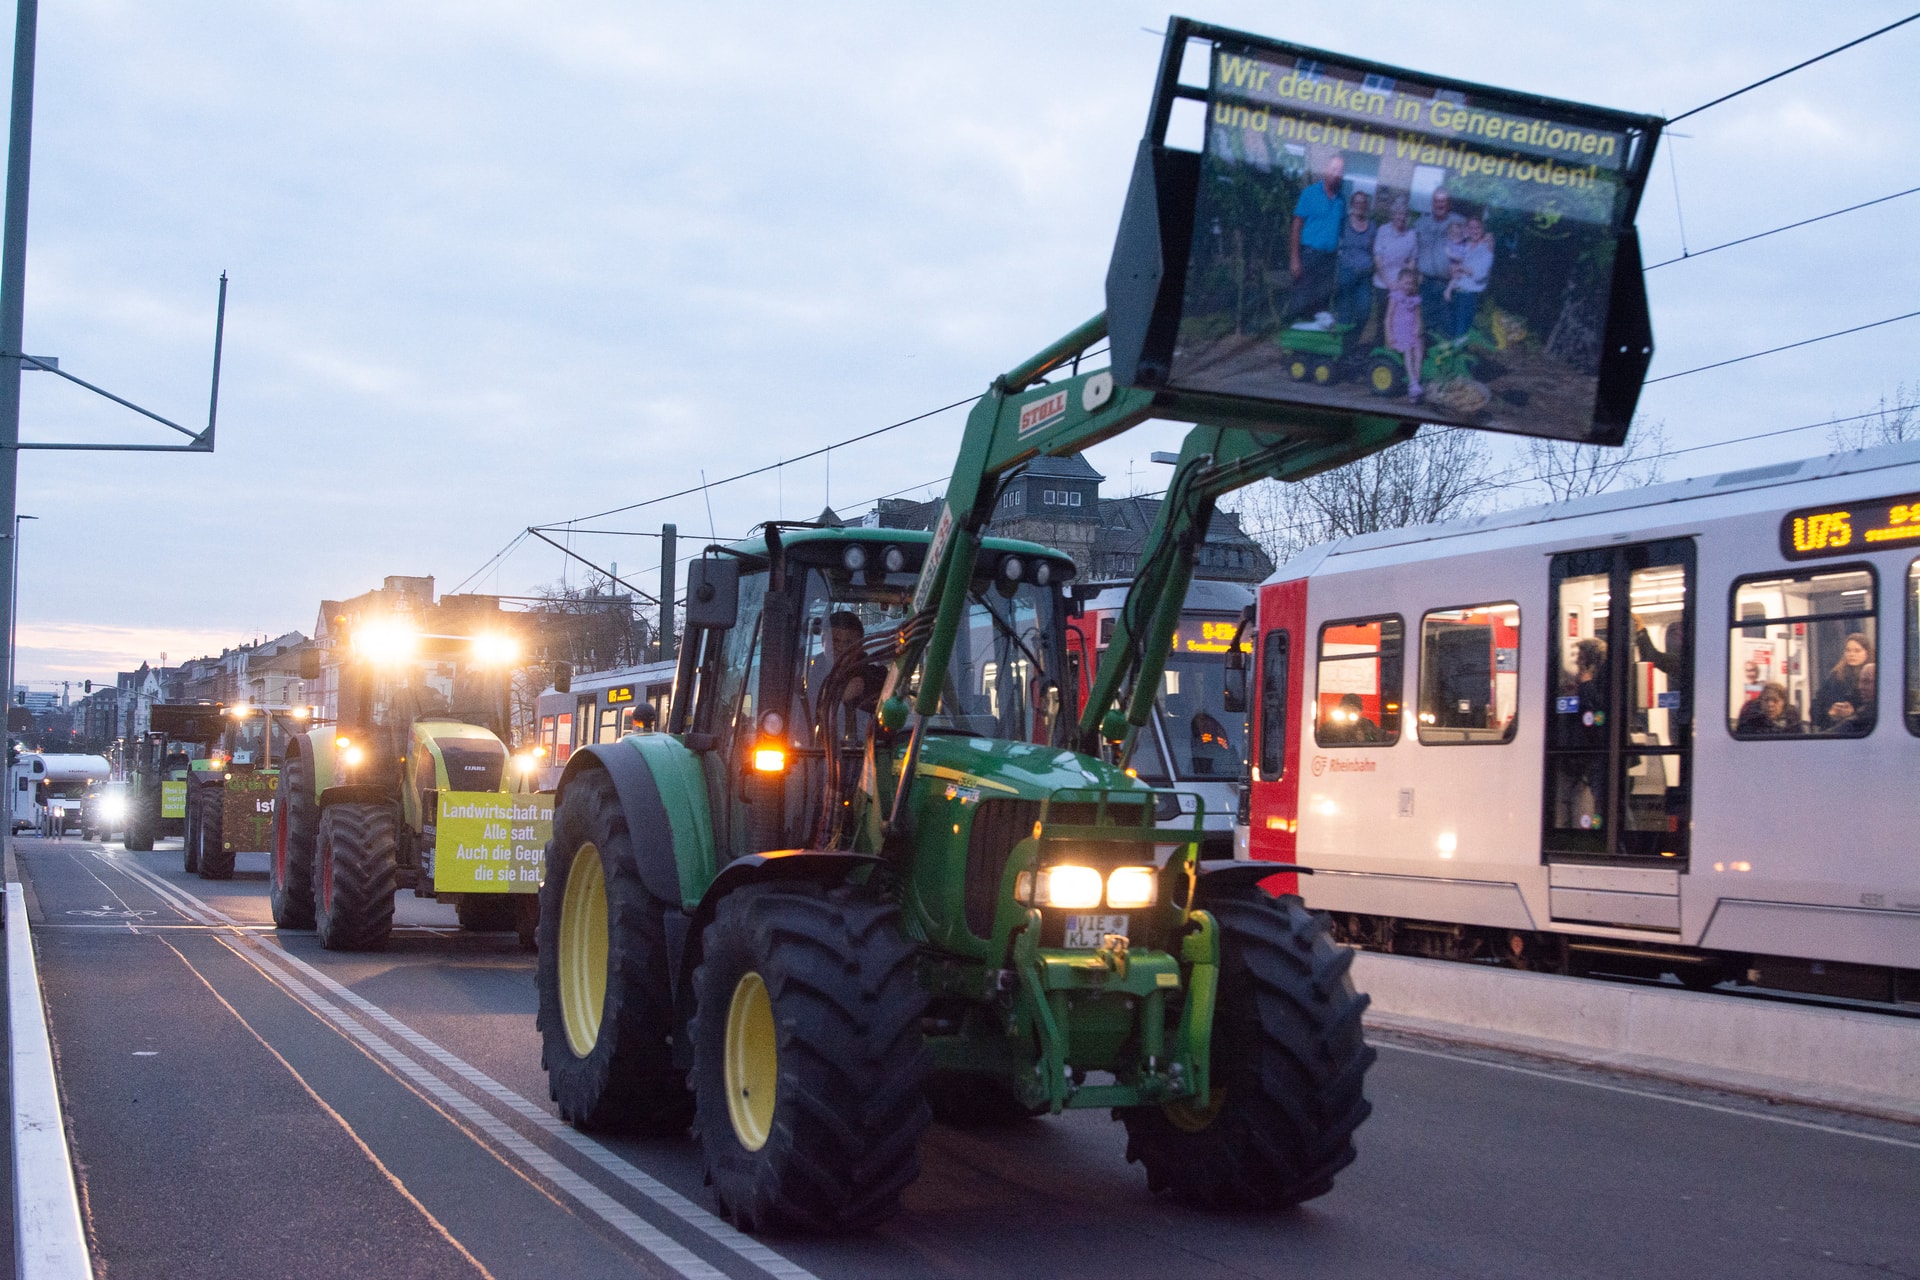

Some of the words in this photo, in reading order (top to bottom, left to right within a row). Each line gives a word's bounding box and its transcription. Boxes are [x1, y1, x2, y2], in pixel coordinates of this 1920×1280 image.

[1220, 52, 1270, 91] Wir
[1278, 70, 1384, 118] denken
[1395, 92, 1420, 123] in
[1429, 102, 1616, 158] Generationen
[1215, 101, 1267, 133] und
[1277, 112, 1350, 152] nicht
[1360, 124, 1385, 155] in
[1395, 129, 1598, 189] Wahlperioden!
[1021, 394, 1065, 430] STOLL
[1793, 511, 1853, 552] U75
[255, 798, 275, 812] ist
[443, 801, 538, 820] Landwirtschaft
[541, 808, 553, 820] m
[483, 824, 507, 839] Alle
[511, 826, 537, 840] satt.
[456, 844, 488, 860] Auch
[492, 845, 511, 860] die
[475, 865, 494, 880] die
[498, 866, 516, 881] sie
[1078, 916, 1106, 931] VIE
